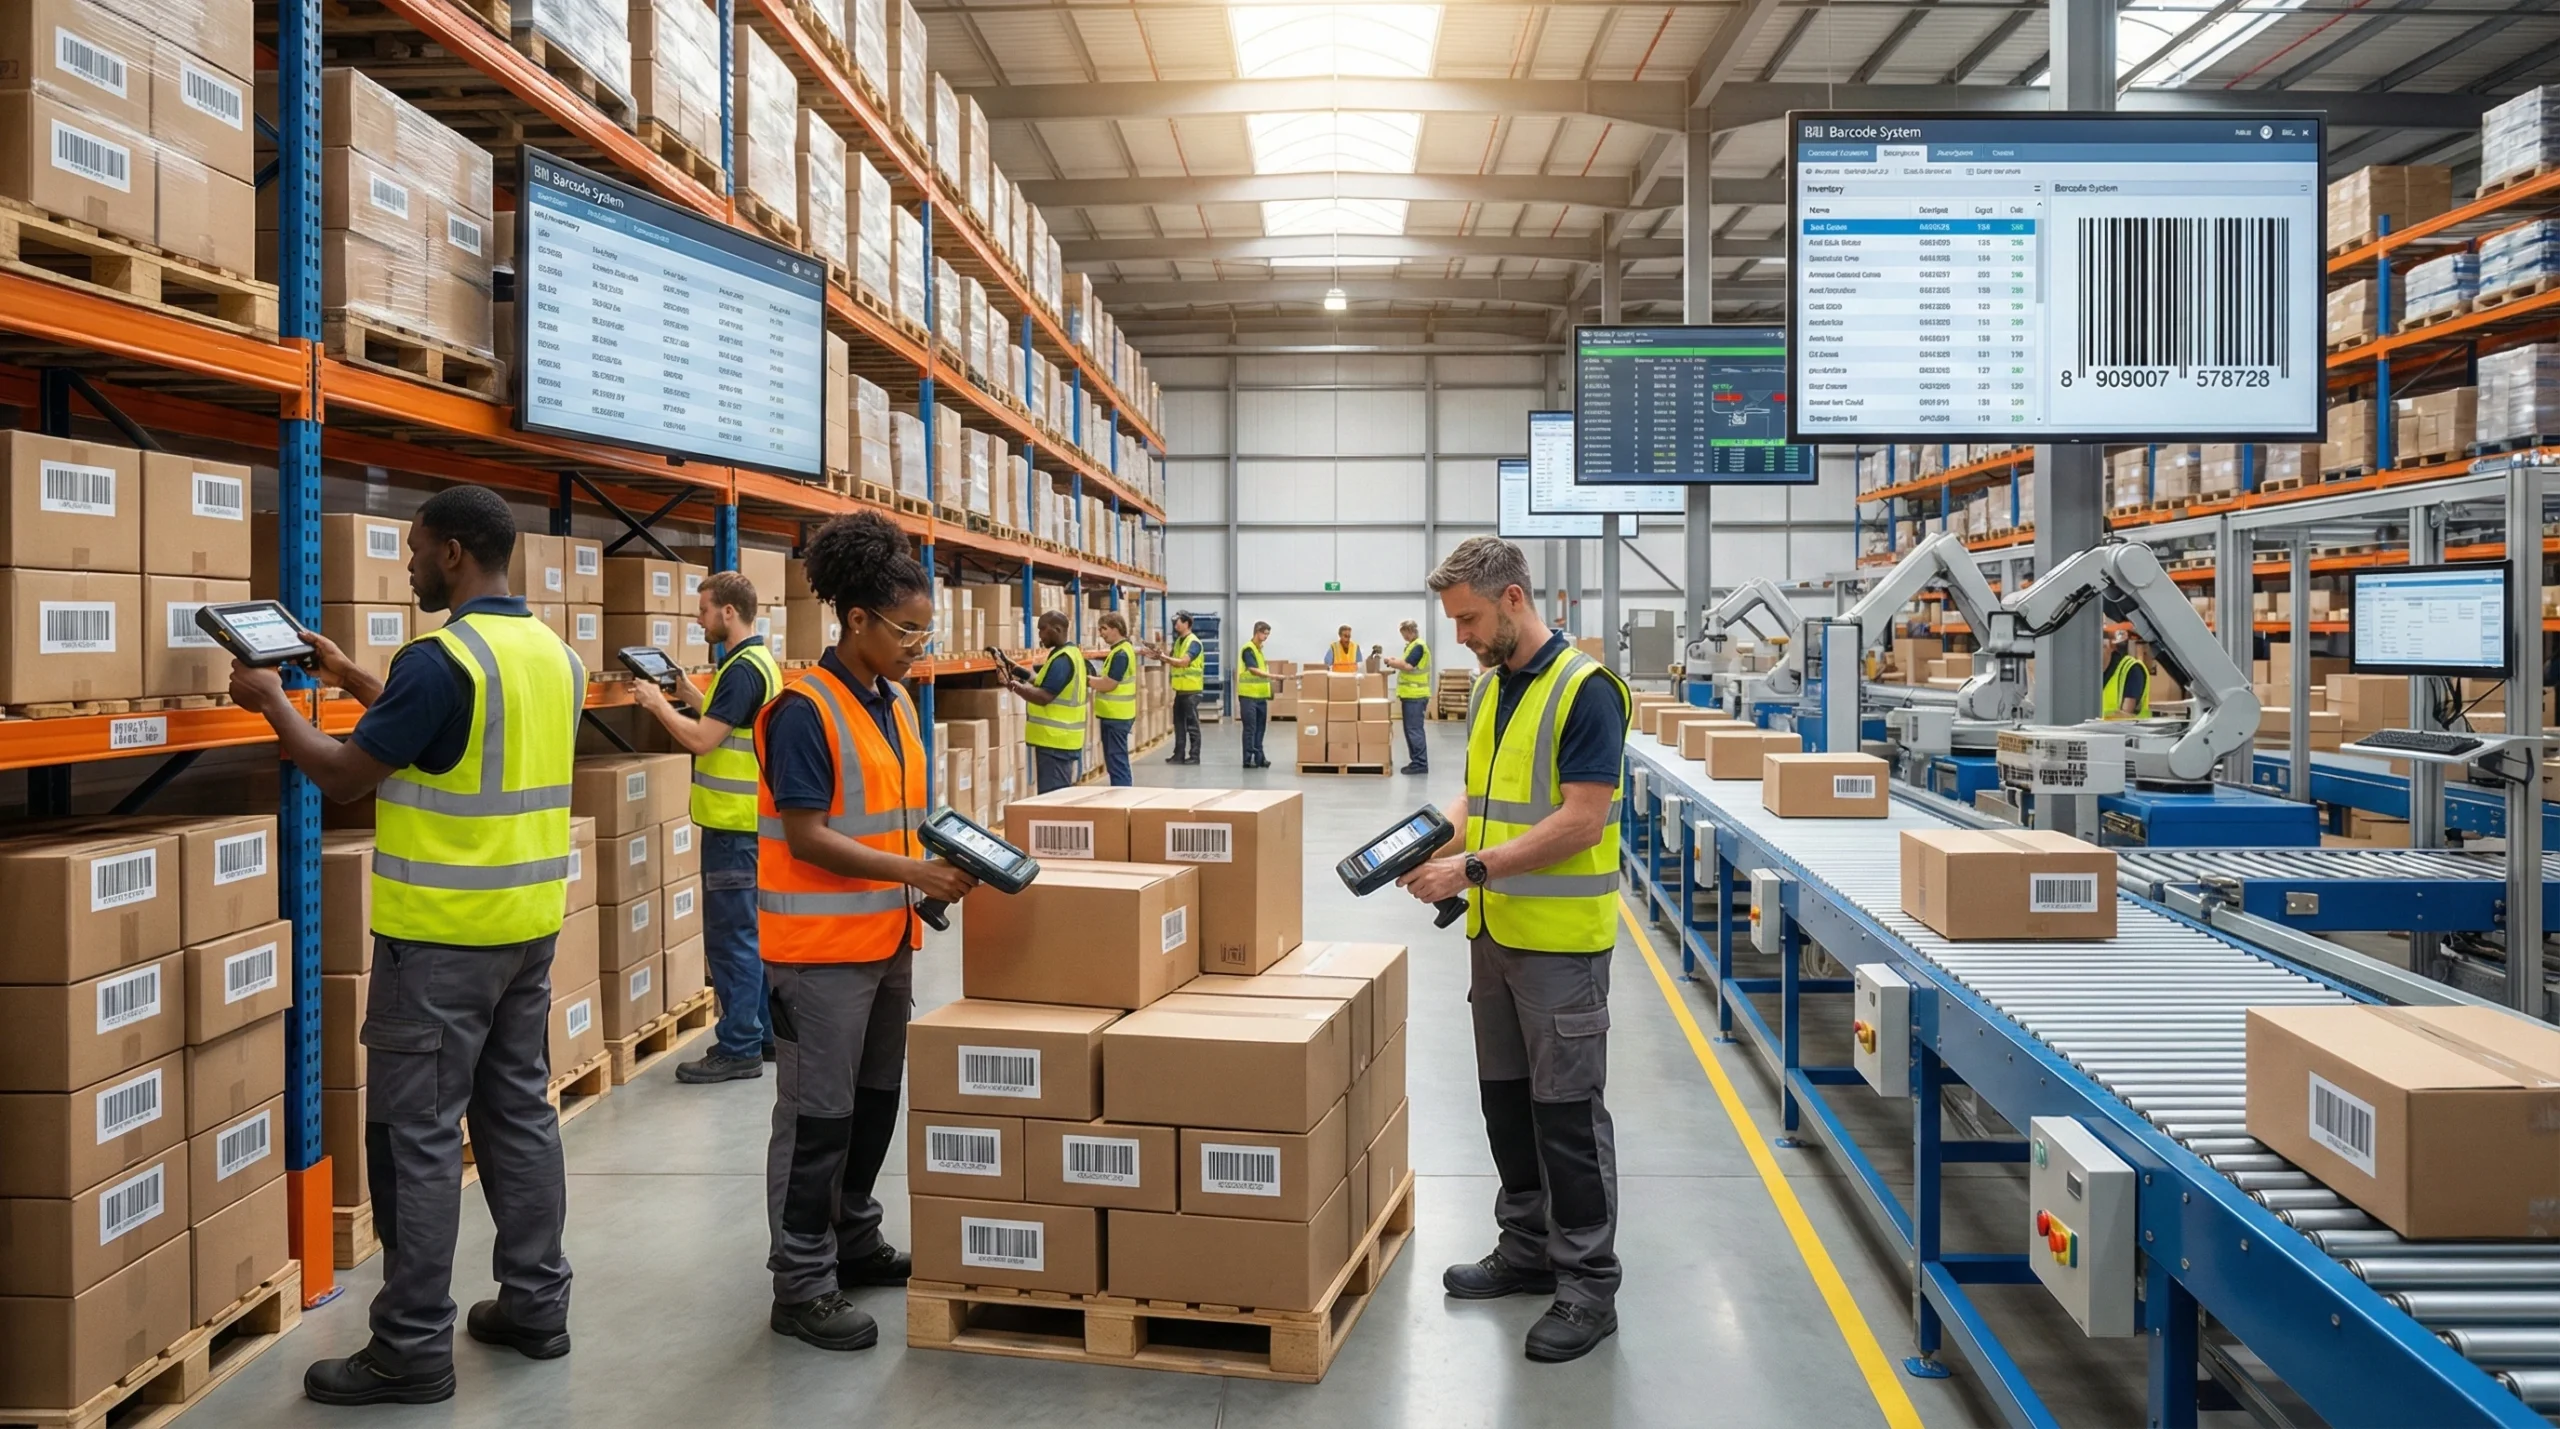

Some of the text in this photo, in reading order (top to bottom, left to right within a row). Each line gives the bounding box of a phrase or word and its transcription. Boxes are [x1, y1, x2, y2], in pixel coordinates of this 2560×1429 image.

[1830, 125, 1877, 137] Barcode
[1880, 126, 1921, 140] System
[2060, 370, 2270, 387] 8 909007 578728
